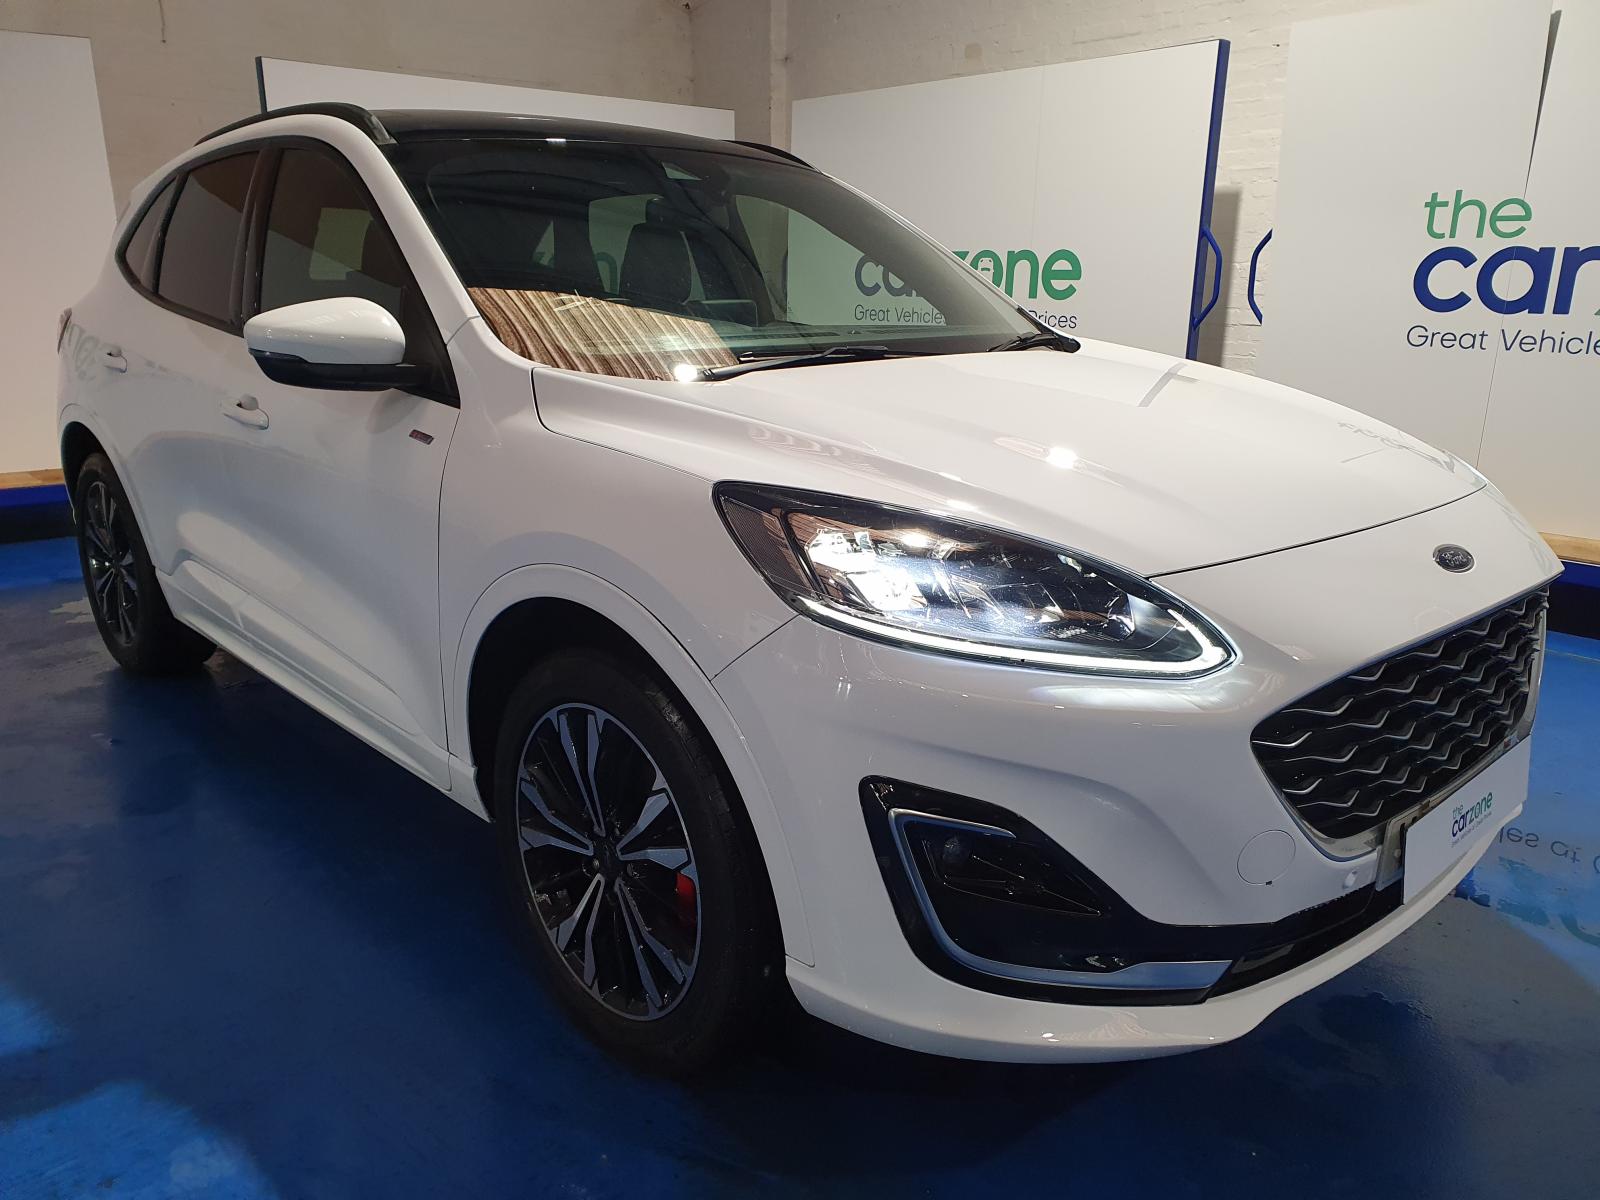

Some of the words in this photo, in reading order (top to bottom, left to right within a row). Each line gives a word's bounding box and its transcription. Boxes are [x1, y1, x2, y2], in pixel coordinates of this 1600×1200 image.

[1424, 189, 1532, 239] the
[1413, 245, 1600, 315] car
[854, 304, 891, 322] Great
[894, 307, 946, 324] Vehicle
[1406, 325, 1489, 350] Great
[1451, 792, 1493, 838] carzone
[1452, 804, 1464, 820] the
